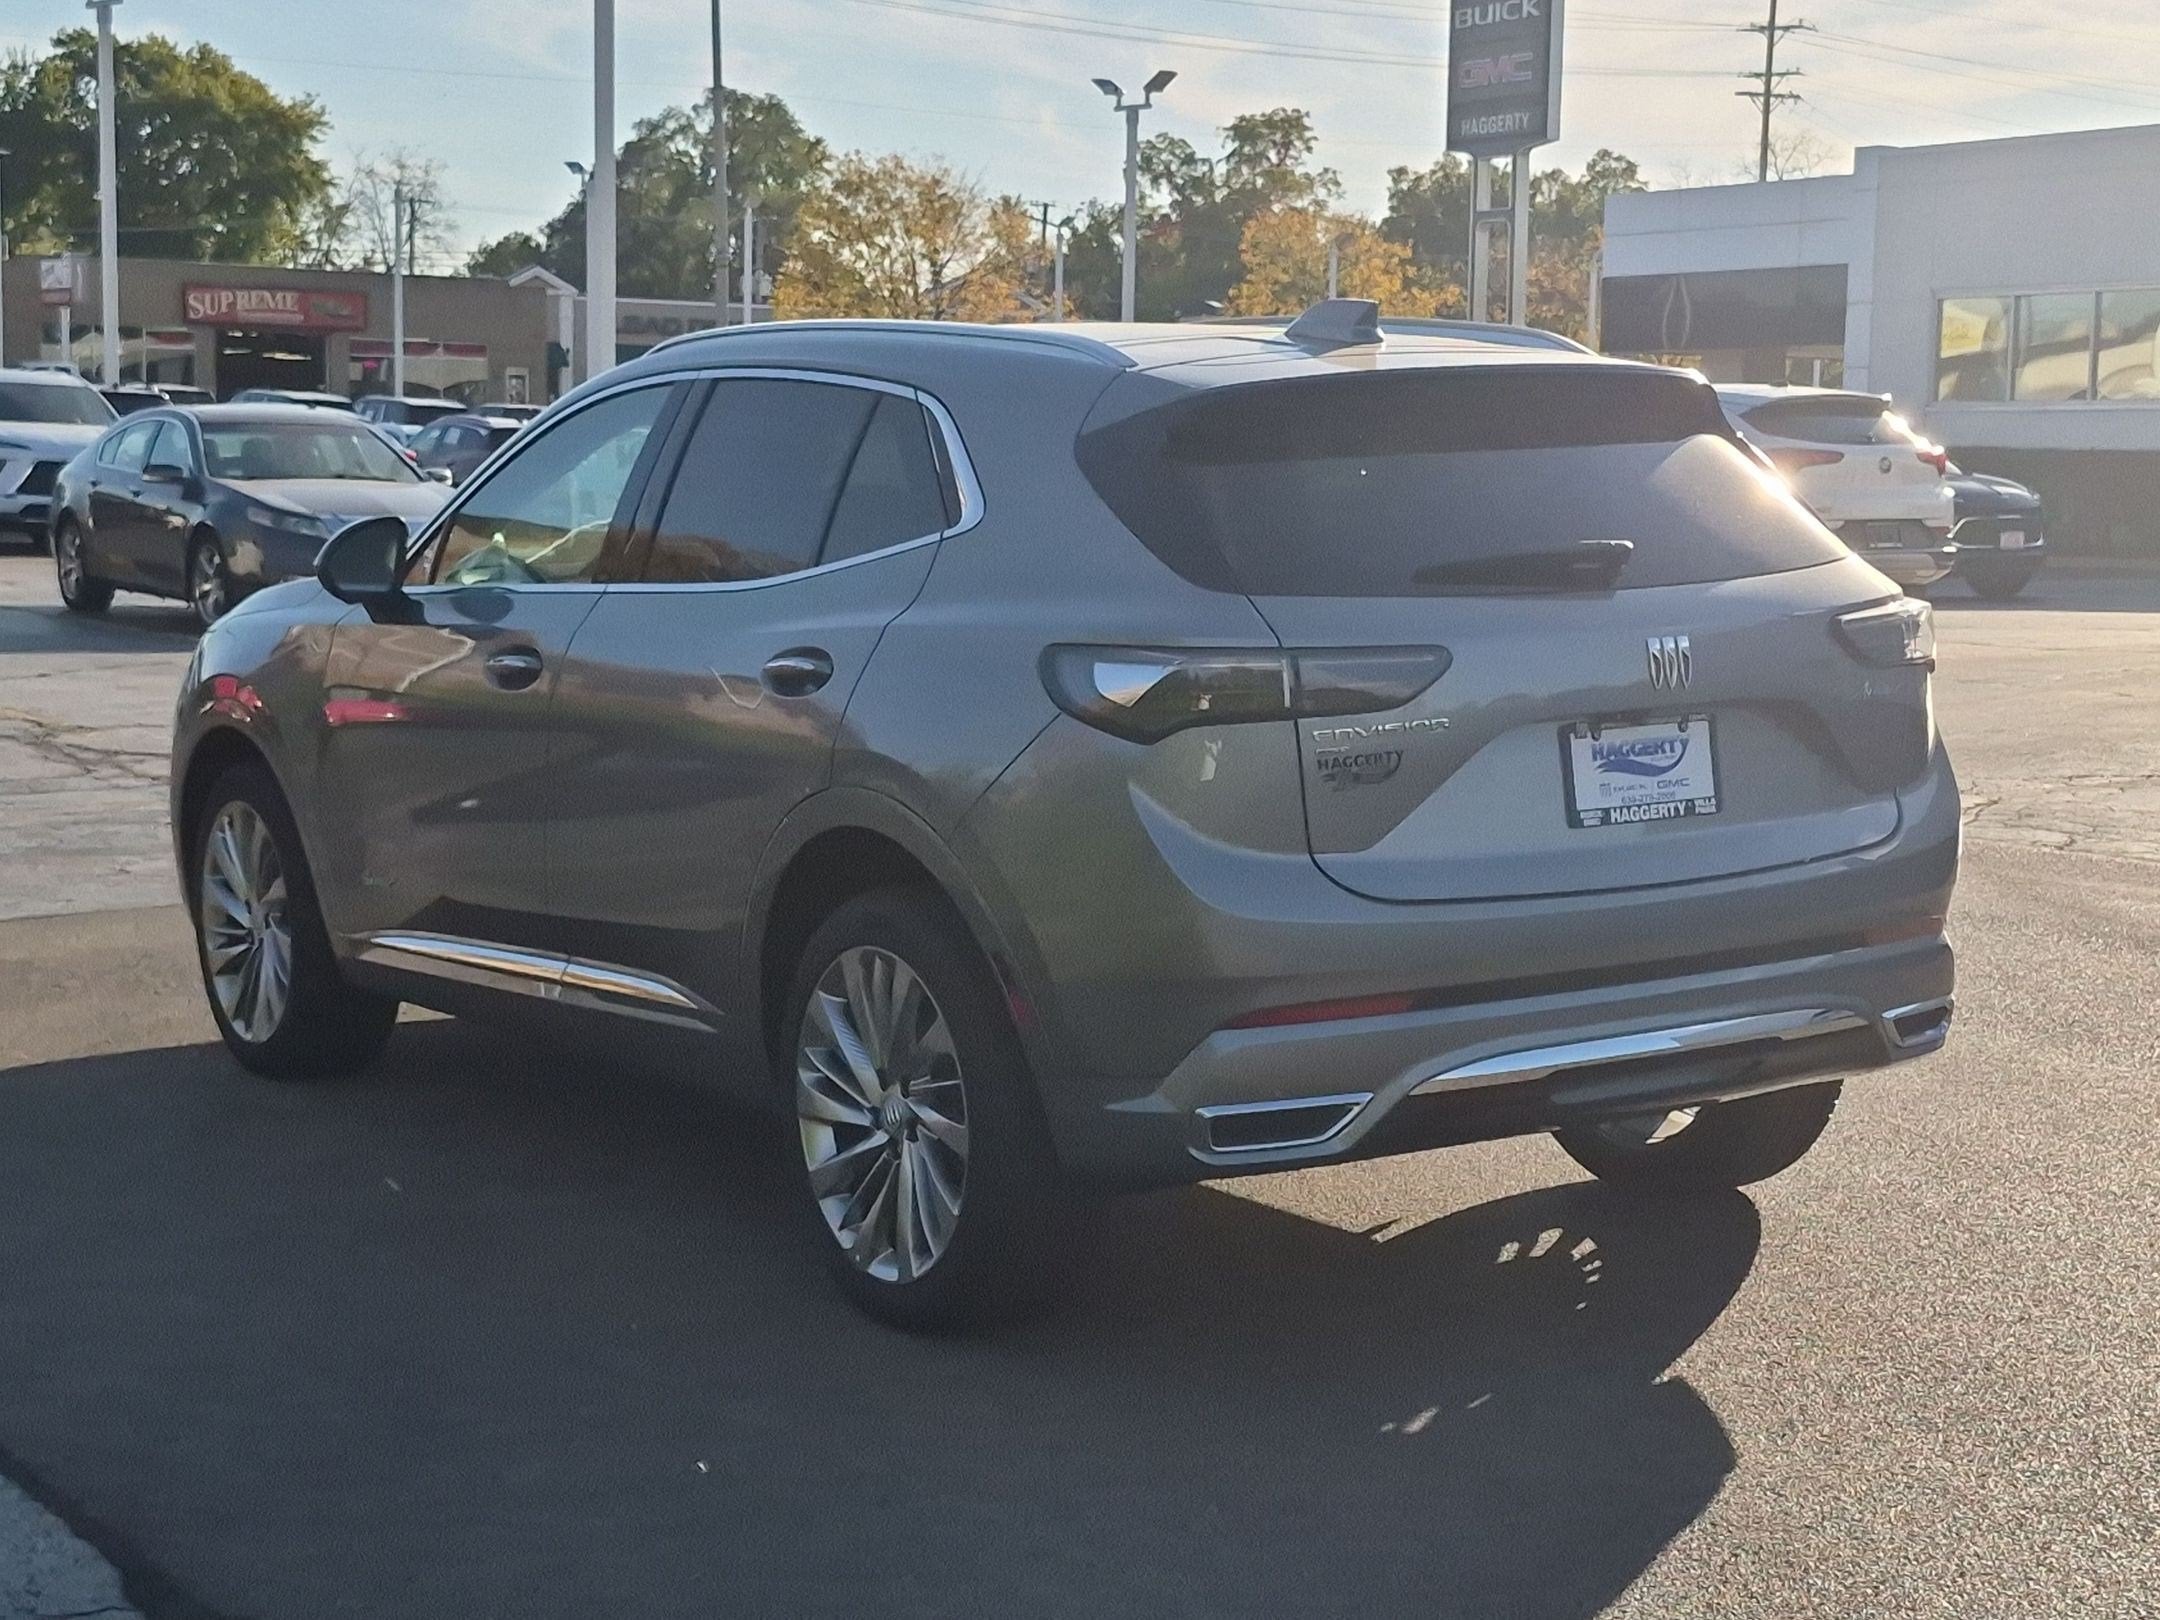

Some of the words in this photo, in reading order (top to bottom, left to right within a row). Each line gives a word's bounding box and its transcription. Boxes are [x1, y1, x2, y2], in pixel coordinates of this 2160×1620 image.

[1455, 0, 1541, 29] BUICK
[1460, 52, 1534, 88] GMC
[1460, 112, 1531, 137] HAGGERTY
[187, 290, 300, 319] SUPREME
[1317, 751, 1404, 771] HAGGERTY
[1591, 735, 1690, 762] HAGGERTY
[1656, 777, 1690, 790] GMC
[1610, 801, 1686, 824] HAGGERTY
